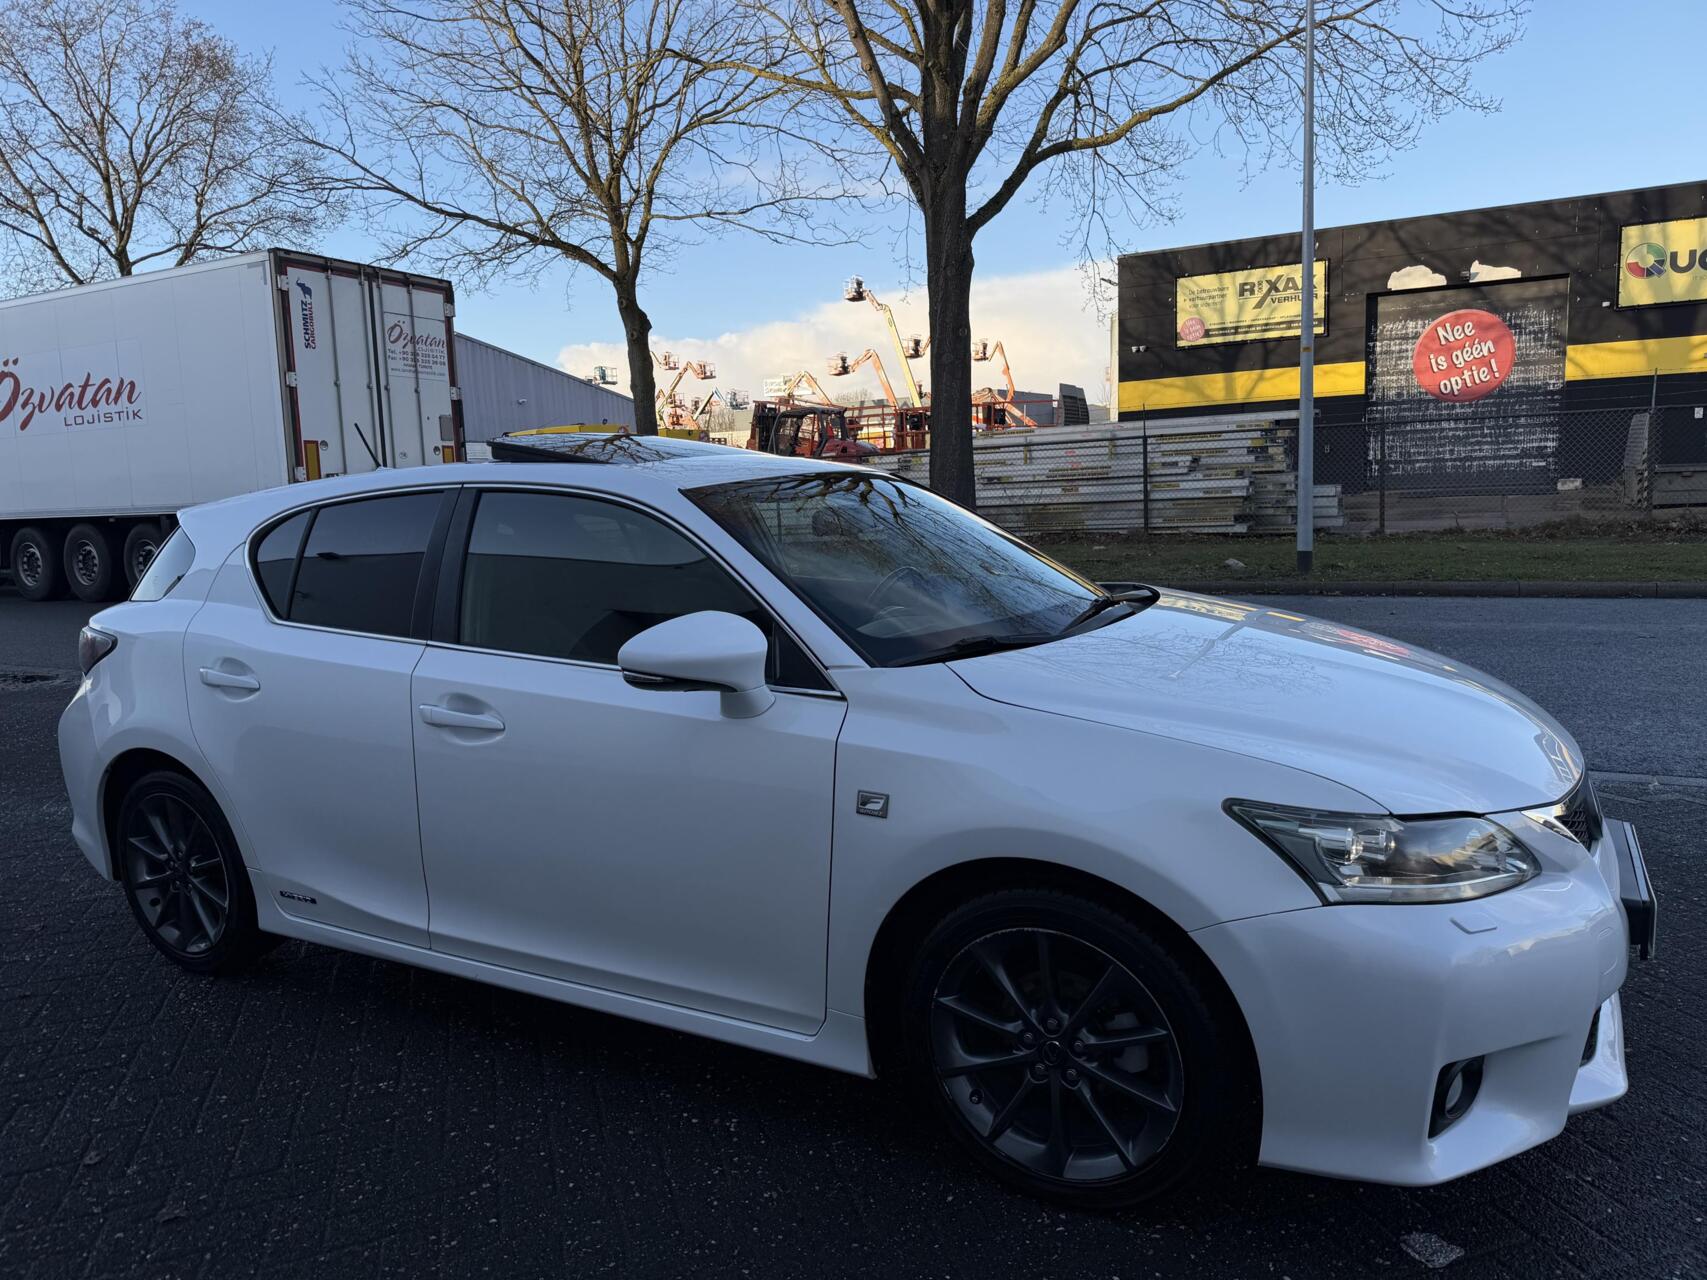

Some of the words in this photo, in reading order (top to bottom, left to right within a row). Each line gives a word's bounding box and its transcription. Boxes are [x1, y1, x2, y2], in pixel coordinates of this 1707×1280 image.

[301, 299, 311, 350] SCHMITZ
[307, 301, 317, 350] CARGOBULL
[1436, 321, 1476, 346] Nee
[1428, 353, 1449, 373] is
[1451, 339, 1497, 368] géén
[1439, 358, 1500, 396] optie!
[63, 406, 144, 427] LOJİSTİK
